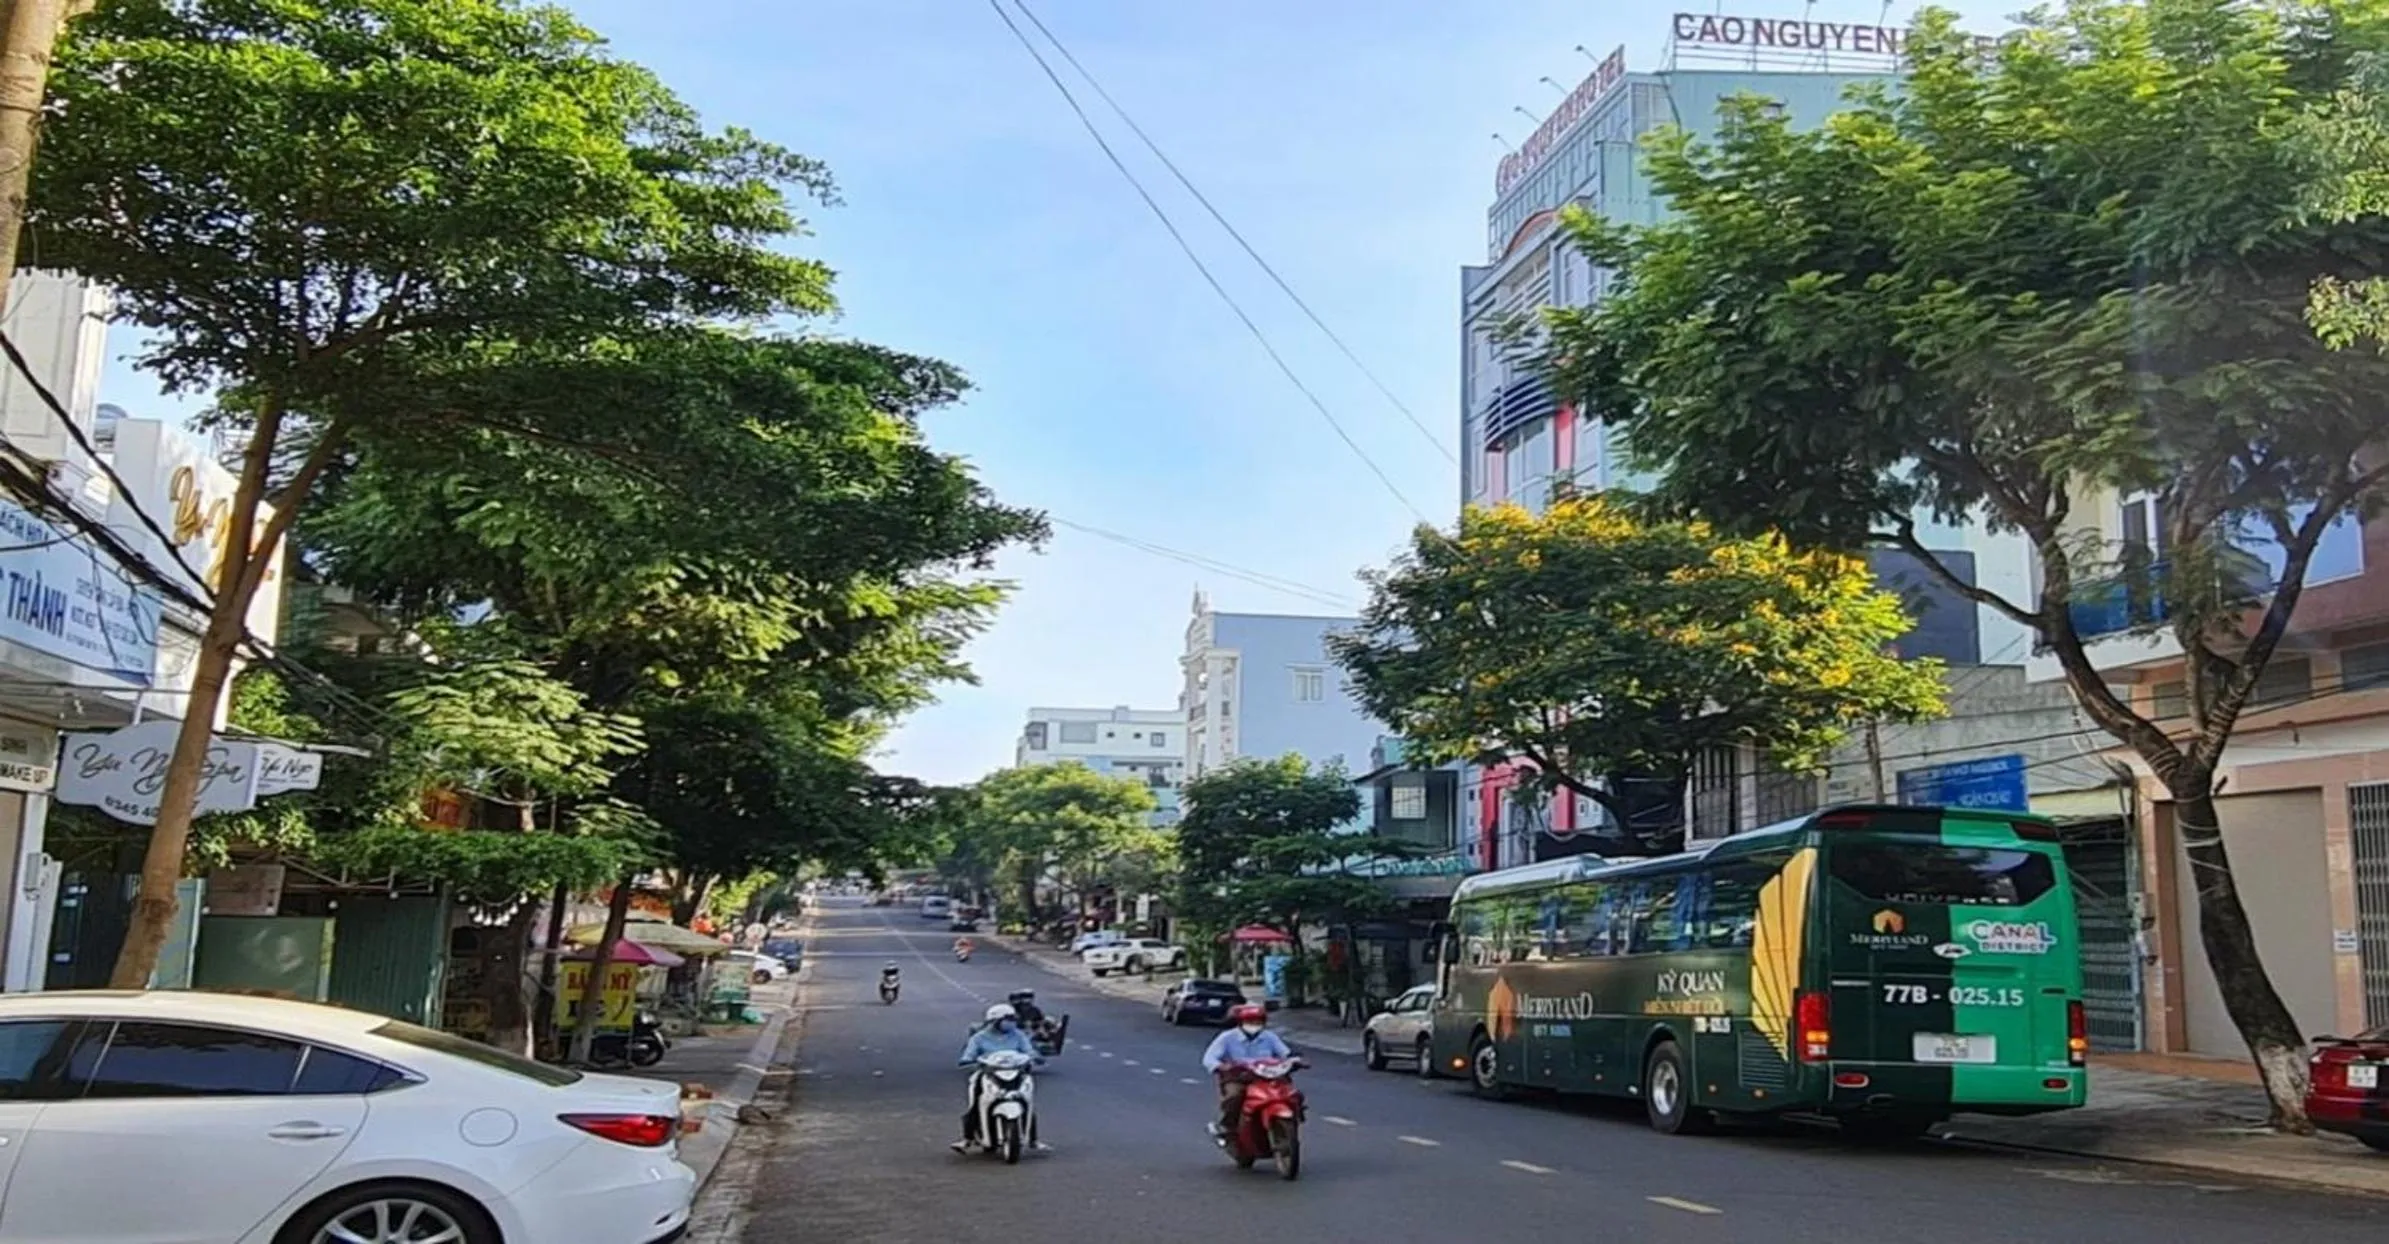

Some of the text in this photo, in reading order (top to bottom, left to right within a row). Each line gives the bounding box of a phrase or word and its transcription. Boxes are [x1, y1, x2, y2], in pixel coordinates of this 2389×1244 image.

[1674, 13, 1745, 45] CAO
[1753, 19, 1898, 54] NGUYEN
[8, 569, 67, 637] THÀNH
[0, 763, 48, 784] MAKE UP
[1972, 922, 2056, 942] CANAL
[1680, 971, 1725, 997] QUAN
[1884, 984, 1928, 1004] 77B
[1950, 988, 2024, 1006] 025.15
